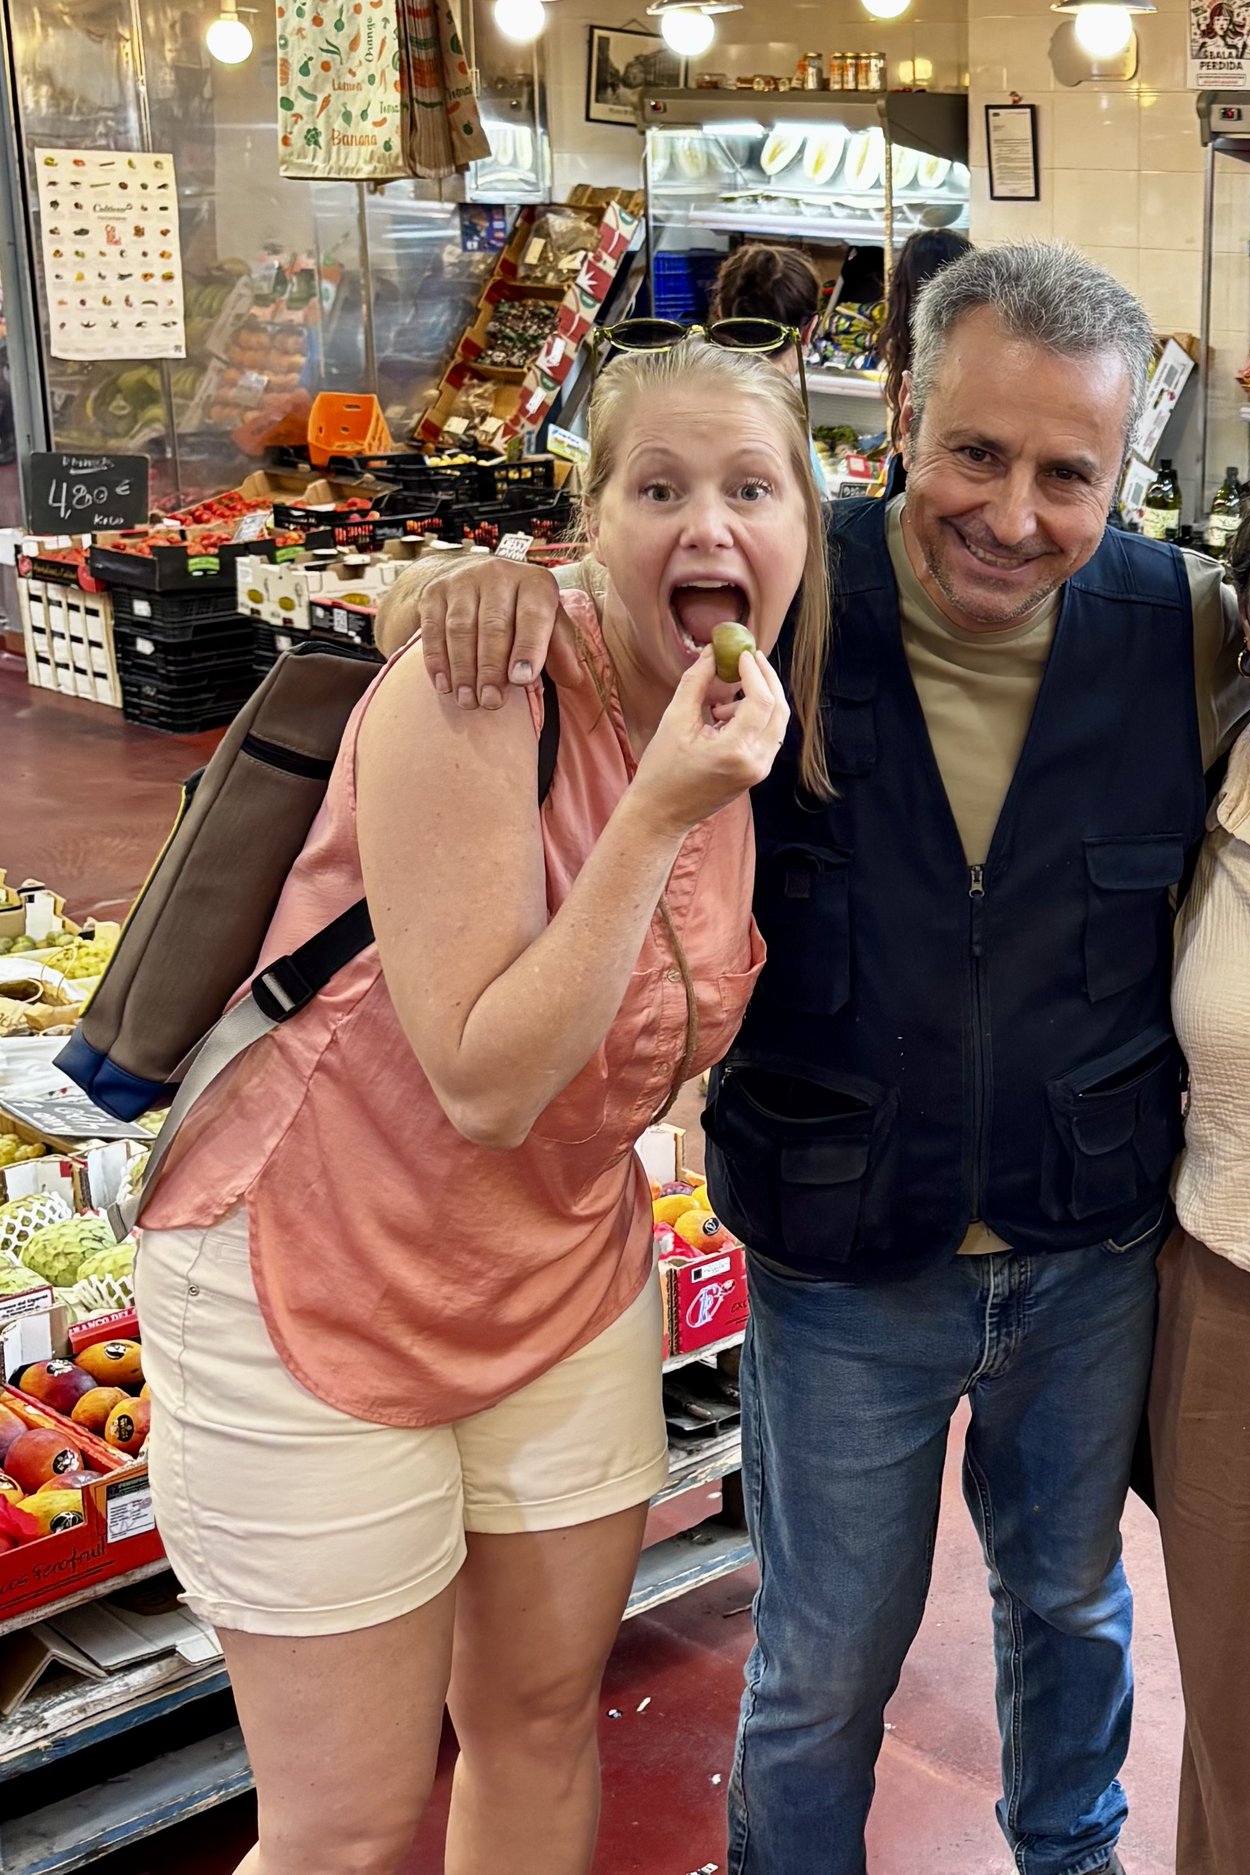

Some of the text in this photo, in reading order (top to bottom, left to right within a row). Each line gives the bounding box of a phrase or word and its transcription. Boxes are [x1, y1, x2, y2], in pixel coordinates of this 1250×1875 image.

[364, 16, 376, 62] Orange
[1199, 61, 1243, 70] PERDIDA
[331, 128, 378, 147] Banana
[115, 480, 132, 495] €
